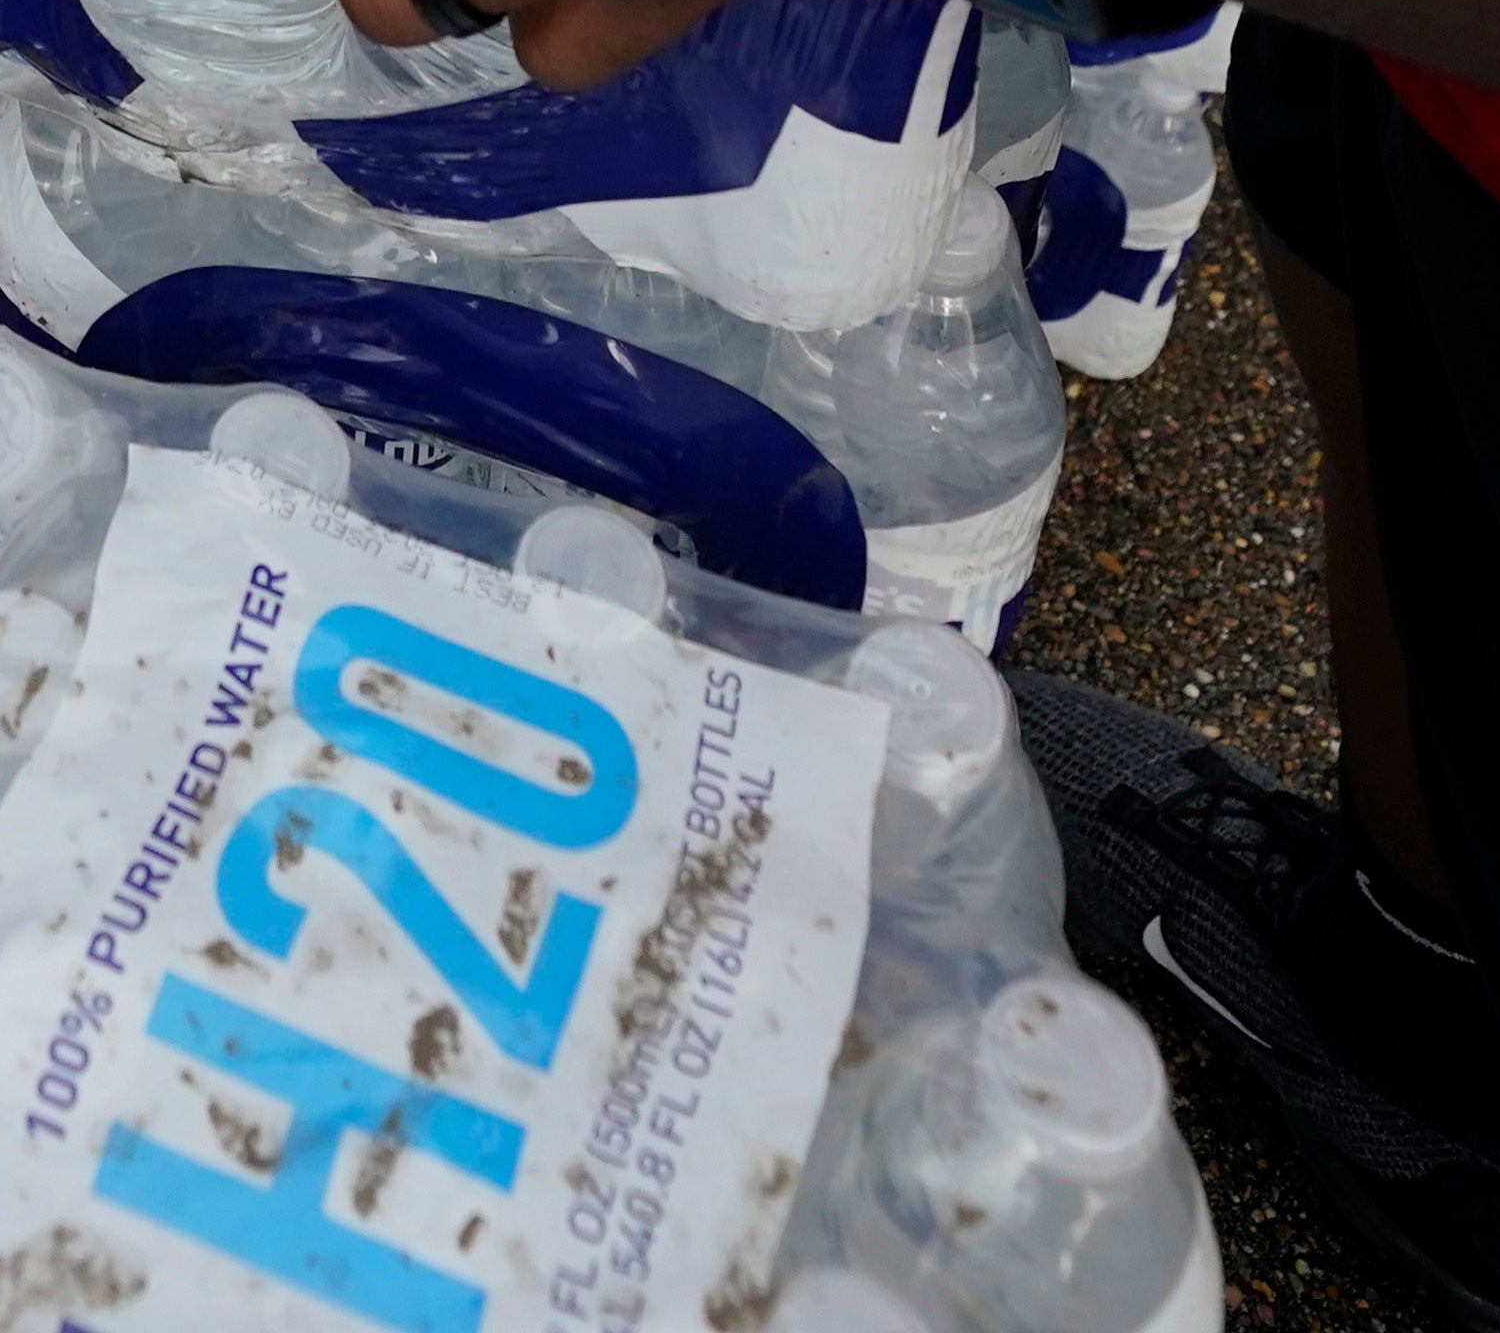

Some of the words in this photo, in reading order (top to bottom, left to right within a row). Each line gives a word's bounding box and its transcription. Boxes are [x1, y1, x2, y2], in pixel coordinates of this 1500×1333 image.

[255, 487, 298, 522] BY
[308, 511, 385, 557] USED
[395, 551, 433, 581] IF
[453, 566, 533, 617] BEST
[21, 984, 115, 1137] 100%
[84, 738, 232, 974] PURIFIED
[206, 561, 291, 724] WATER
[544, 1262, 597, 1321] FL
[683, 666, 742, 840] BOTTLES
[670, 1016, 723, 1078] OZ
[645, 1094, 700, 1147] FL
[606, 1145, 679, 1282] 540.8
